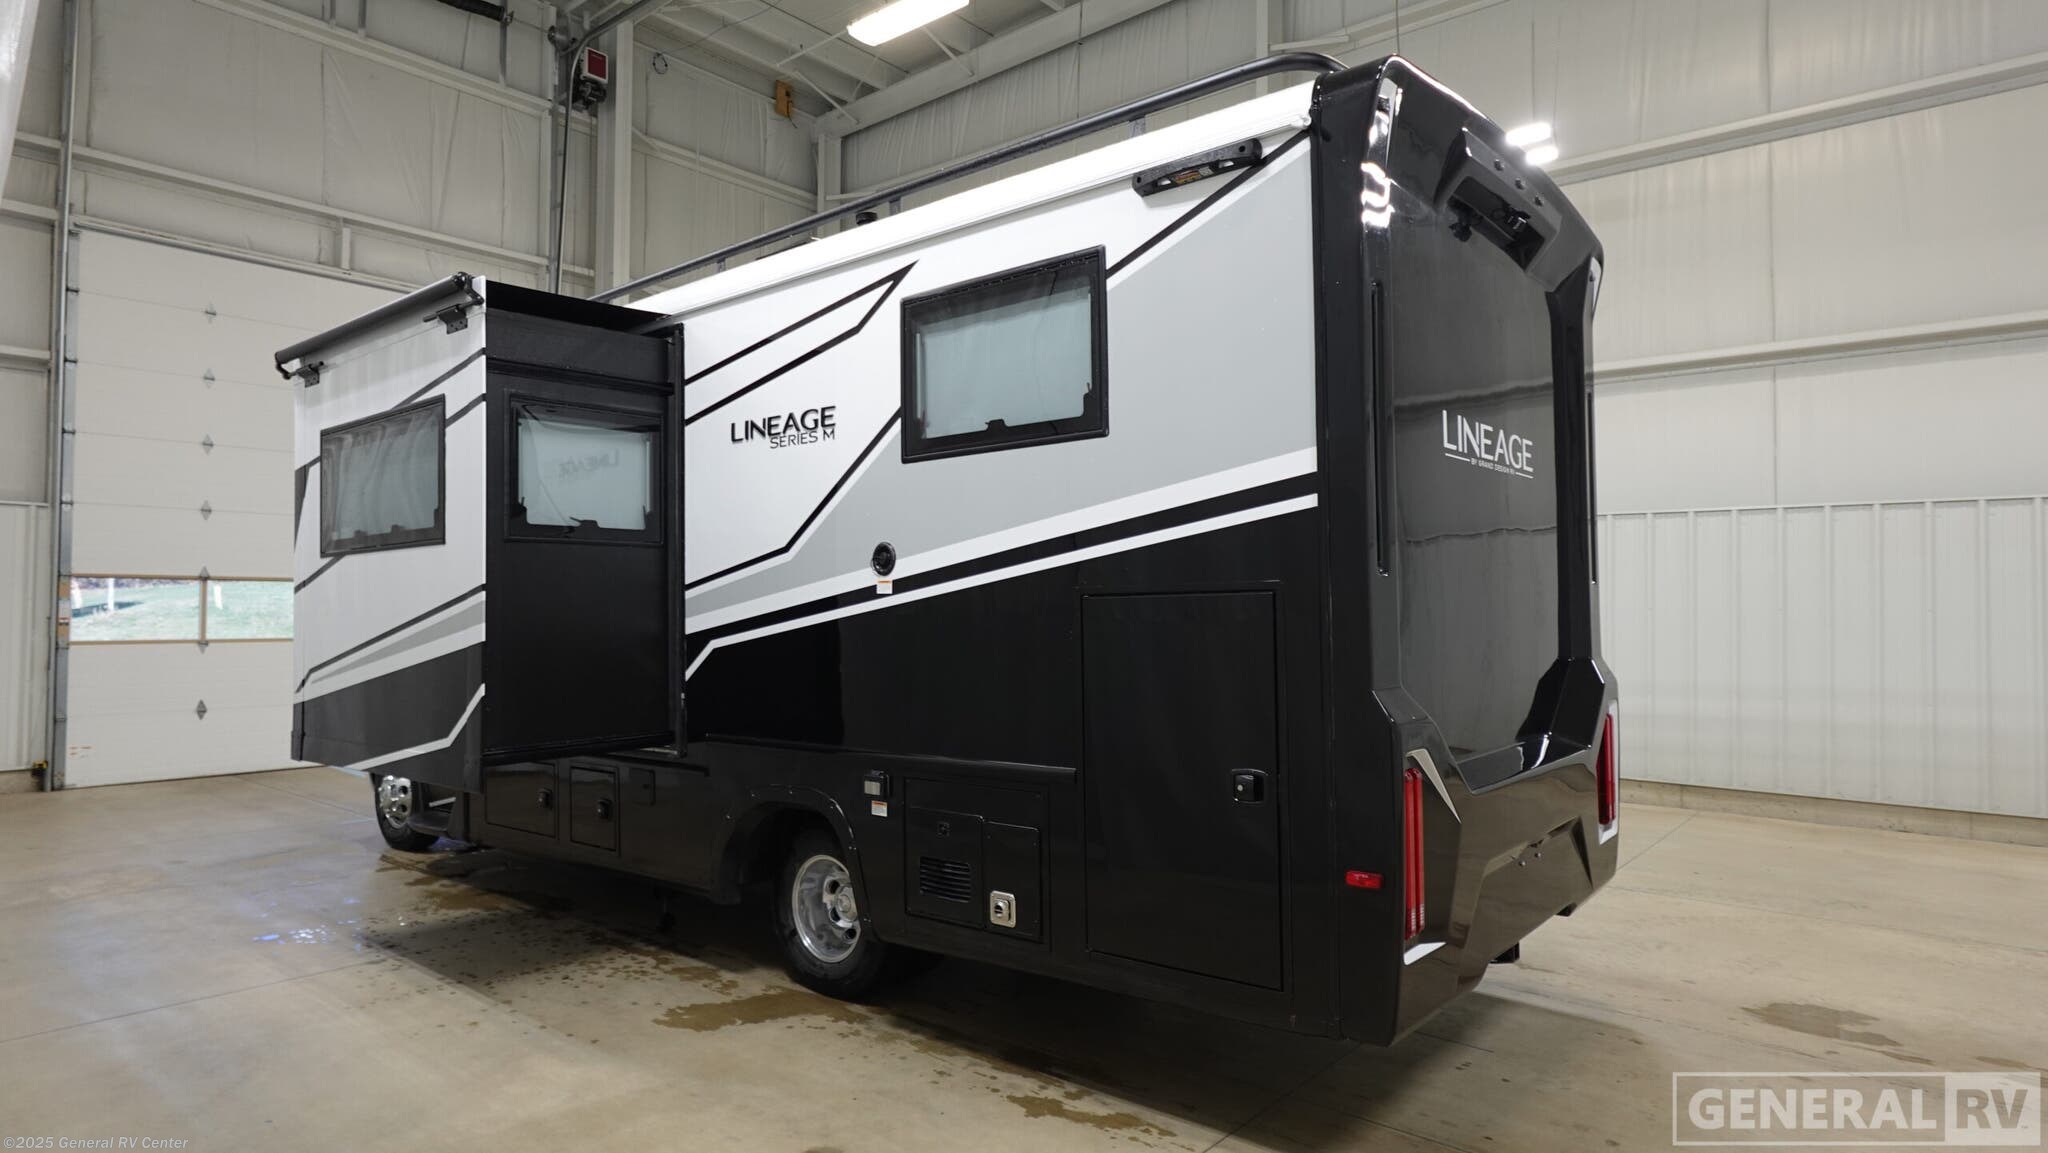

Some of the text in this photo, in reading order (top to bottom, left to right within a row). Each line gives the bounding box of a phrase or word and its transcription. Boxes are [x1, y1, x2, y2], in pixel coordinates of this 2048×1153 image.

[731, 405, 836, 444] LINEAGE
[769, 428, 835, 449] SERIES M
[1442, 409, 1534, 473] LINEAGE
